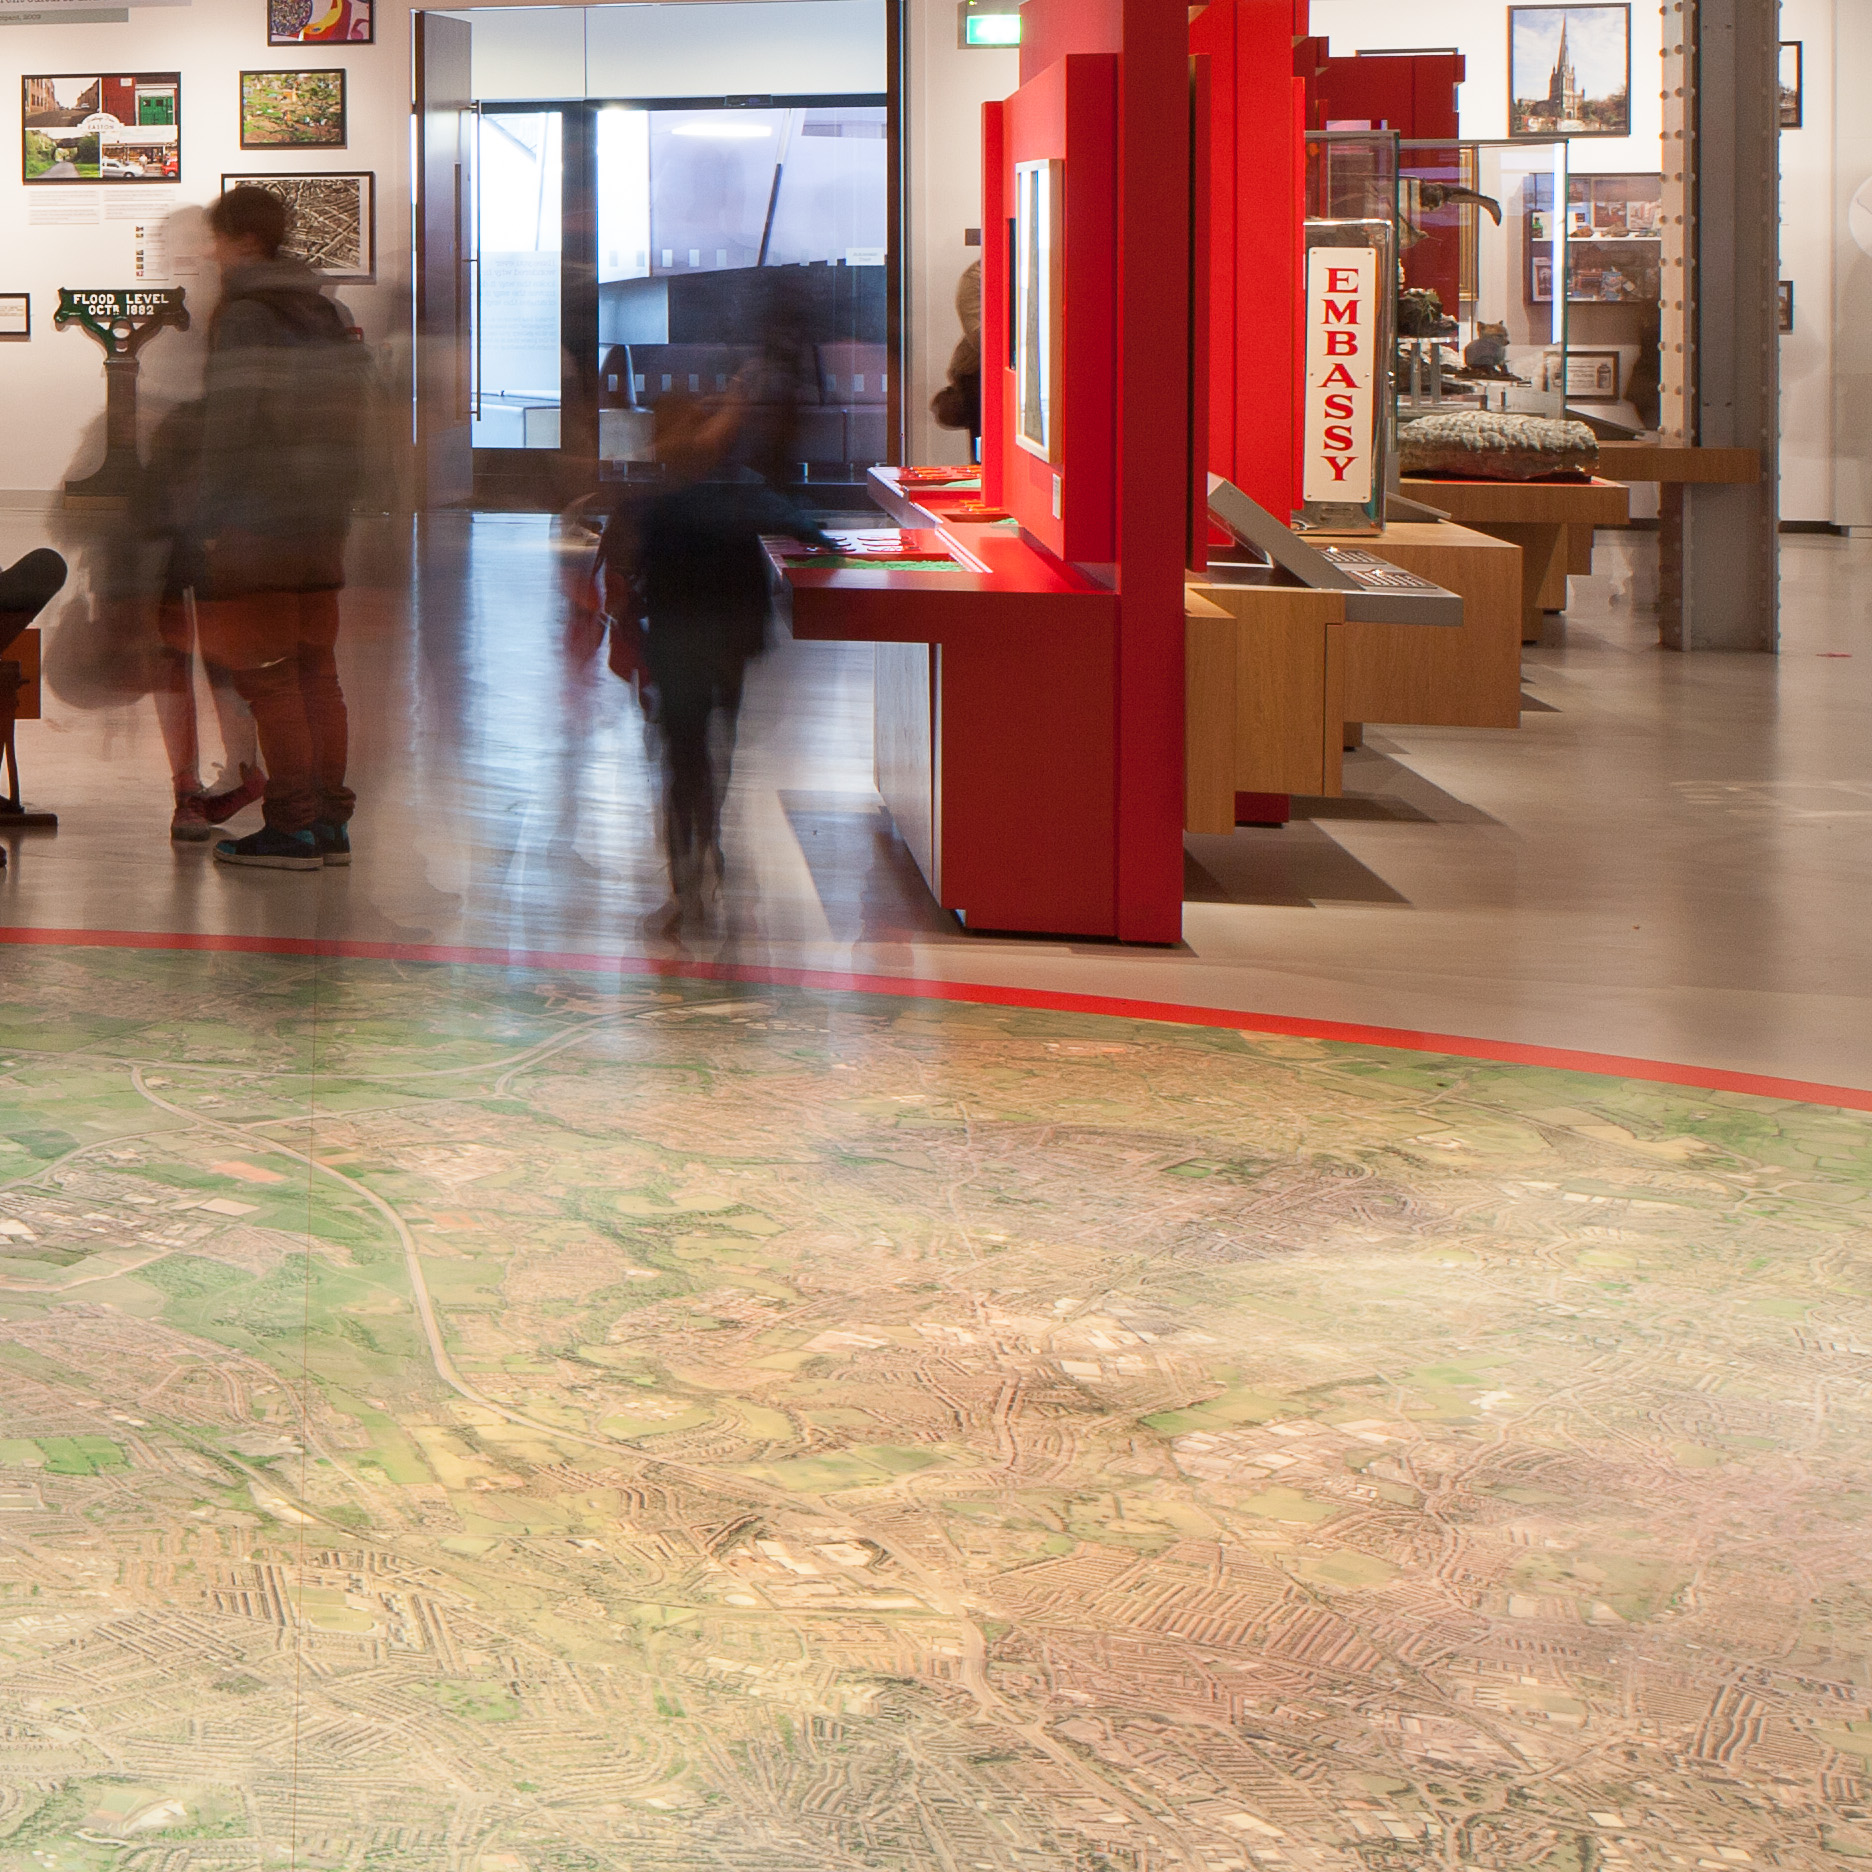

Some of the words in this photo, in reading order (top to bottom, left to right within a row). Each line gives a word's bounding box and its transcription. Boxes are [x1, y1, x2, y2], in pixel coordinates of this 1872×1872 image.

[73, 294, 114, 305] FLOOD
[126, 293, 169, 304] LEVEL
[127, 305, 154, 315] 1882
[1318, 267, 1362, 482] EMBASSY
